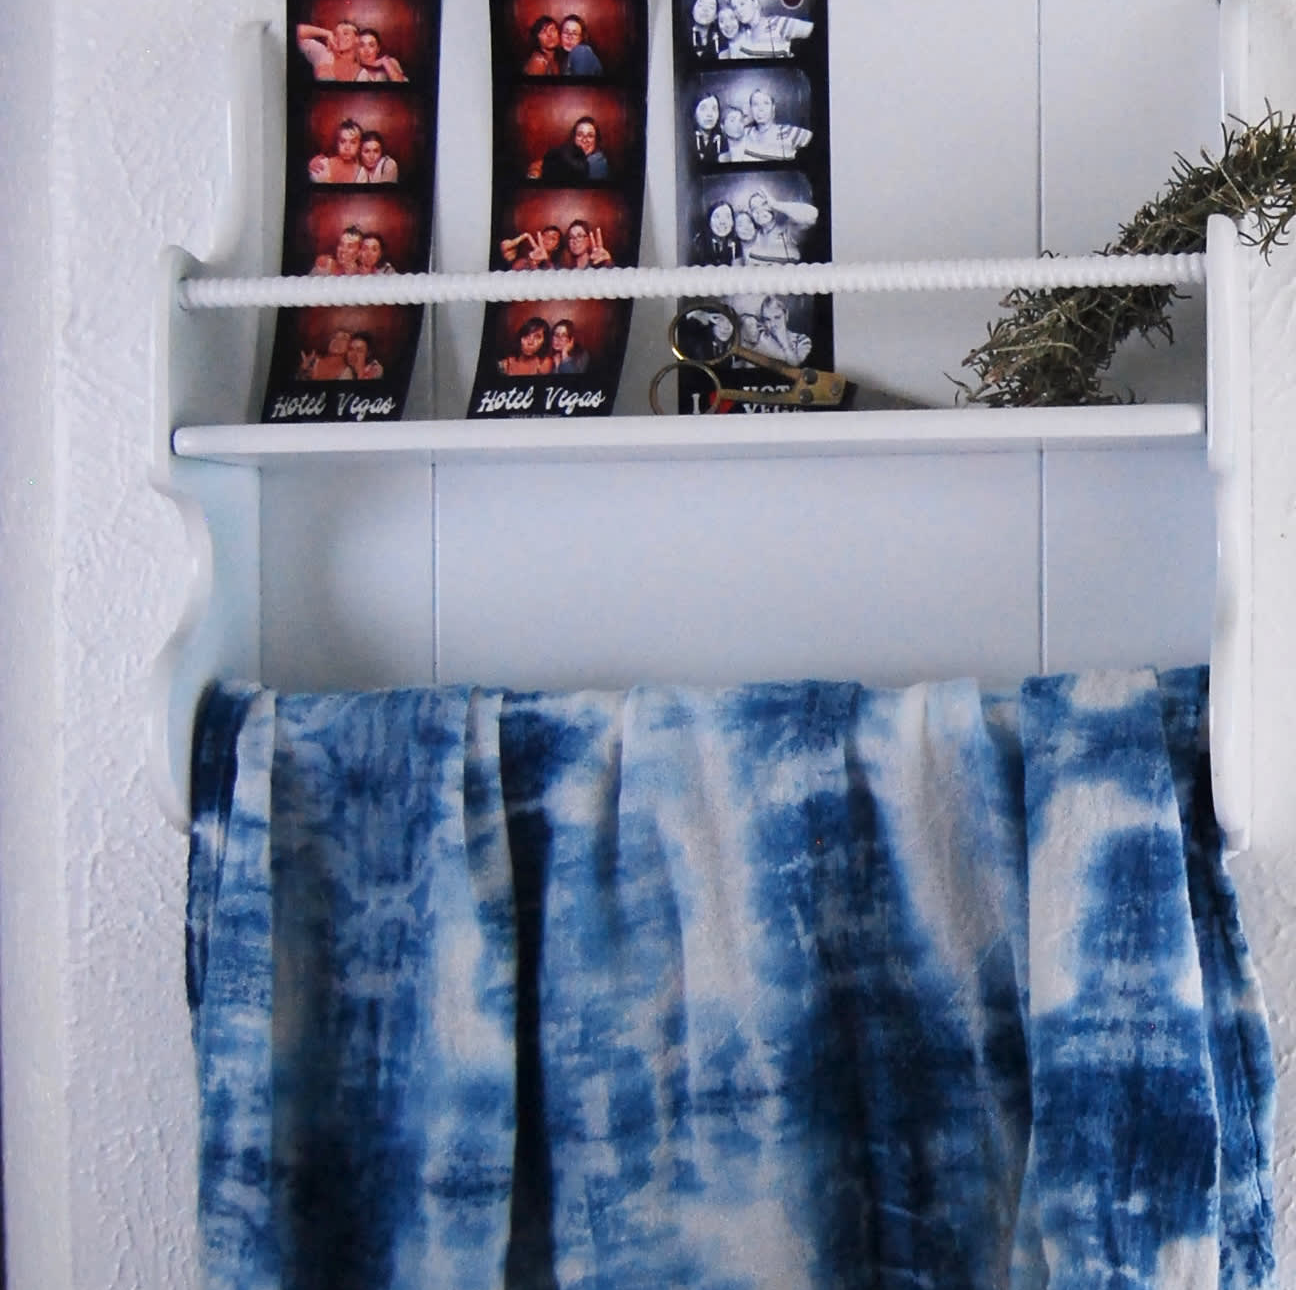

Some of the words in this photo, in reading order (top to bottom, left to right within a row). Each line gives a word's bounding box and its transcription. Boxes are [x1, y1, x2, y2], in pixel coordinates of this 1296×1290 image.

[271, 391, 327, 418] Hotel
[337, 392, 397, 421] Vegas
[476, 385, 534, 413] Hotel
[545, 386, 606, 415] Vegas
